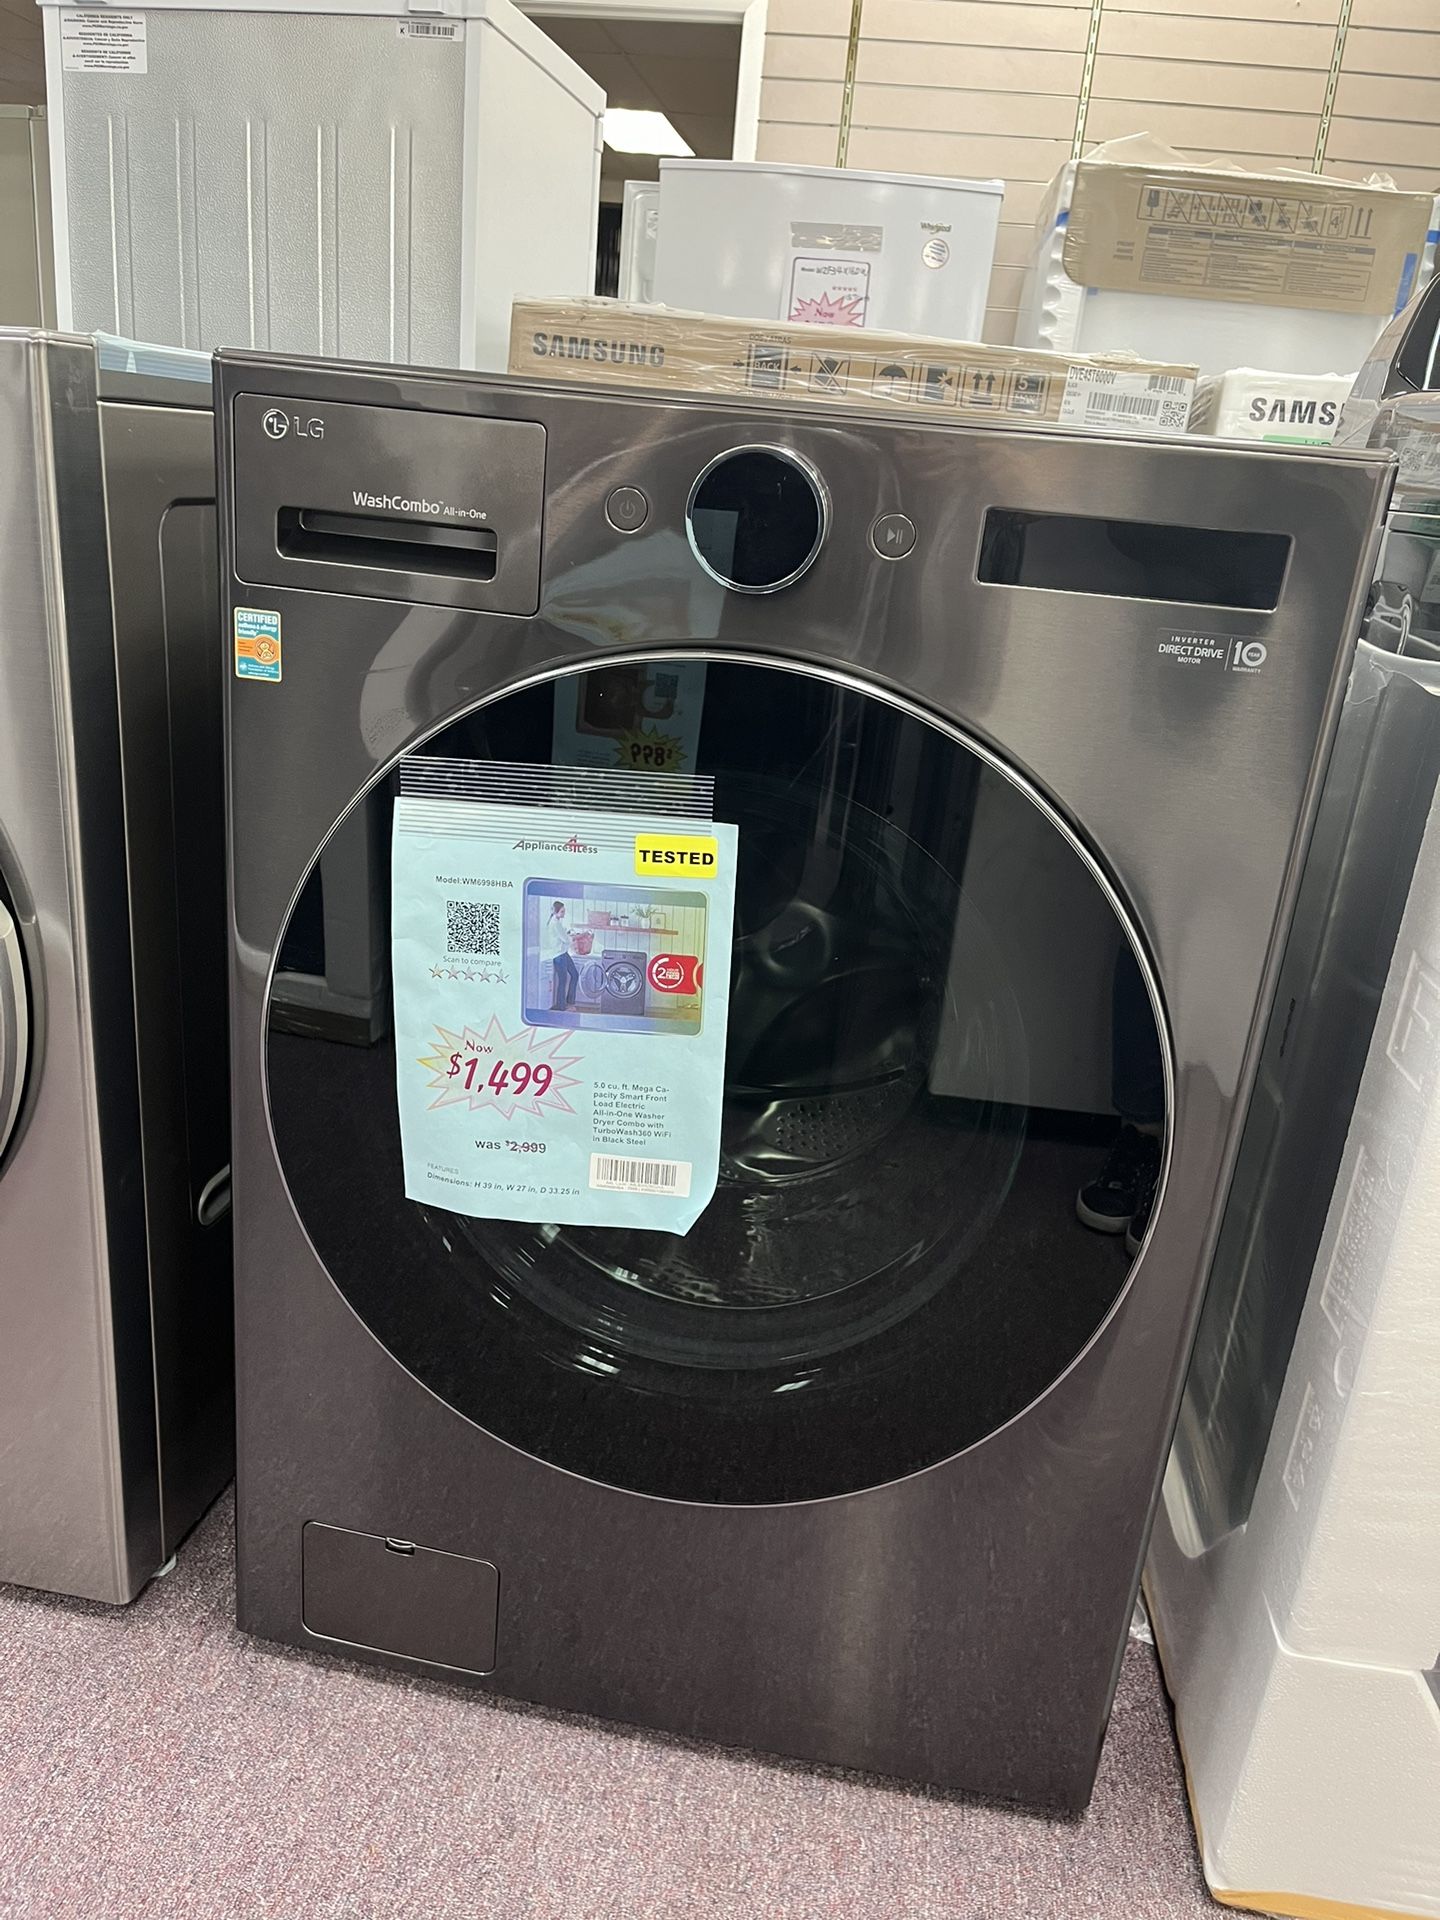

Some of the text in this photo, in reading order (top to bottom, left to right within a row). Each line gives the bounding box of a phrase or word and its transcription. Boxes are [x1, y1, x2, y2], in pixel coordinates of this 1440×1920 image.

[532, 332, 665, 367] SAMSUNG
[754, 361, 780, 372] BACK
[1018, 377, 1029, 390] 5
[1249, 397, 1338, 426] SAMS
[293, 415, 324, 440] LG
[443, 506, 487, 520] All-in-One
[238, 612, 278, 625] CERTIFIED
[1171, 636, 1215, 646] INVERTER
[1158, 643, 1224, 659] DIRECT DRIVE
[1233, 641, 1267, 667] 10
[1177, 656, 1201, 664] MOTOR
[639, 850, 714, 866] TESTED
[443, 955, 502, 967] Scan to compare
[656, 967, 666, 979] 2
[464, 1039, 493, 1054] Now
[446, 1052, 553, 1097] $1,499
[632, 1084, 653, 1093] Mega
[593, 1092, 667, 1102] pacity Smart Front
[593, 1100, 645, 1110] Load Electric
[593, 1109, 633, 1118] All-in-One
[593, 1118, 615, 1126] Dryer
[617, 1119, 645, 1128] Combo
[593, 1127, 671, 1138] TurboWash360 WiFi
[475, 1140, 501, 1150] was
[602, 1136, 624, 1144] Black
[427, 1162, 459, 1175] FEATURES
[427, 1172, 472, 1187] Dimensions:
[548, 1187, 570, 1195] 33.25
